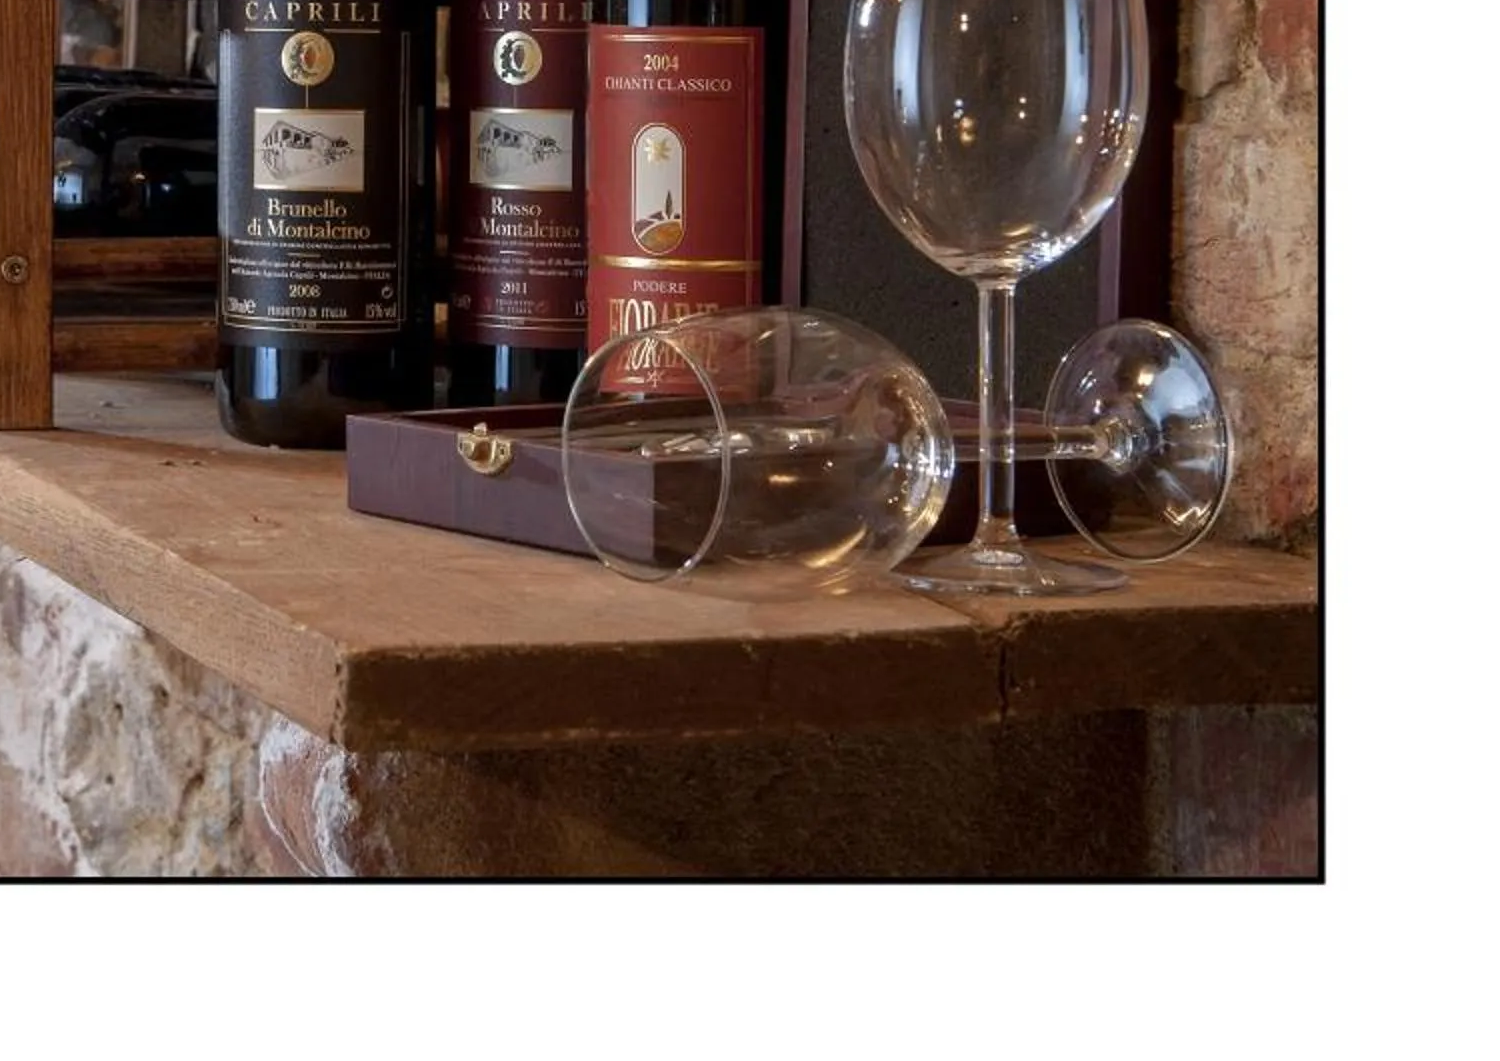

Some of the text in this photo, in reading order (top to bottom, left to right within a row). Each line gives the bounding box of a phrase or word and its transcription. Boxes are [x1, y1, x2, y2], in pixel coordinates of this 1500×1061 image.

[244, 0, 381, 22] CAPRILI
[643, 54, 679, 71] 2004
[605, 76, 732, 92] CHIANTI CLASSICO
[267, 198, 347, 218] Brunello
[491, 196, 542, 216] Rosso
[247, 219, 371, 239] di Montalcino
[480, 218, 580, 238] Montalcino
[500, 282, 528, 295] 2011
[633, 279, 688, 294] PODERE
